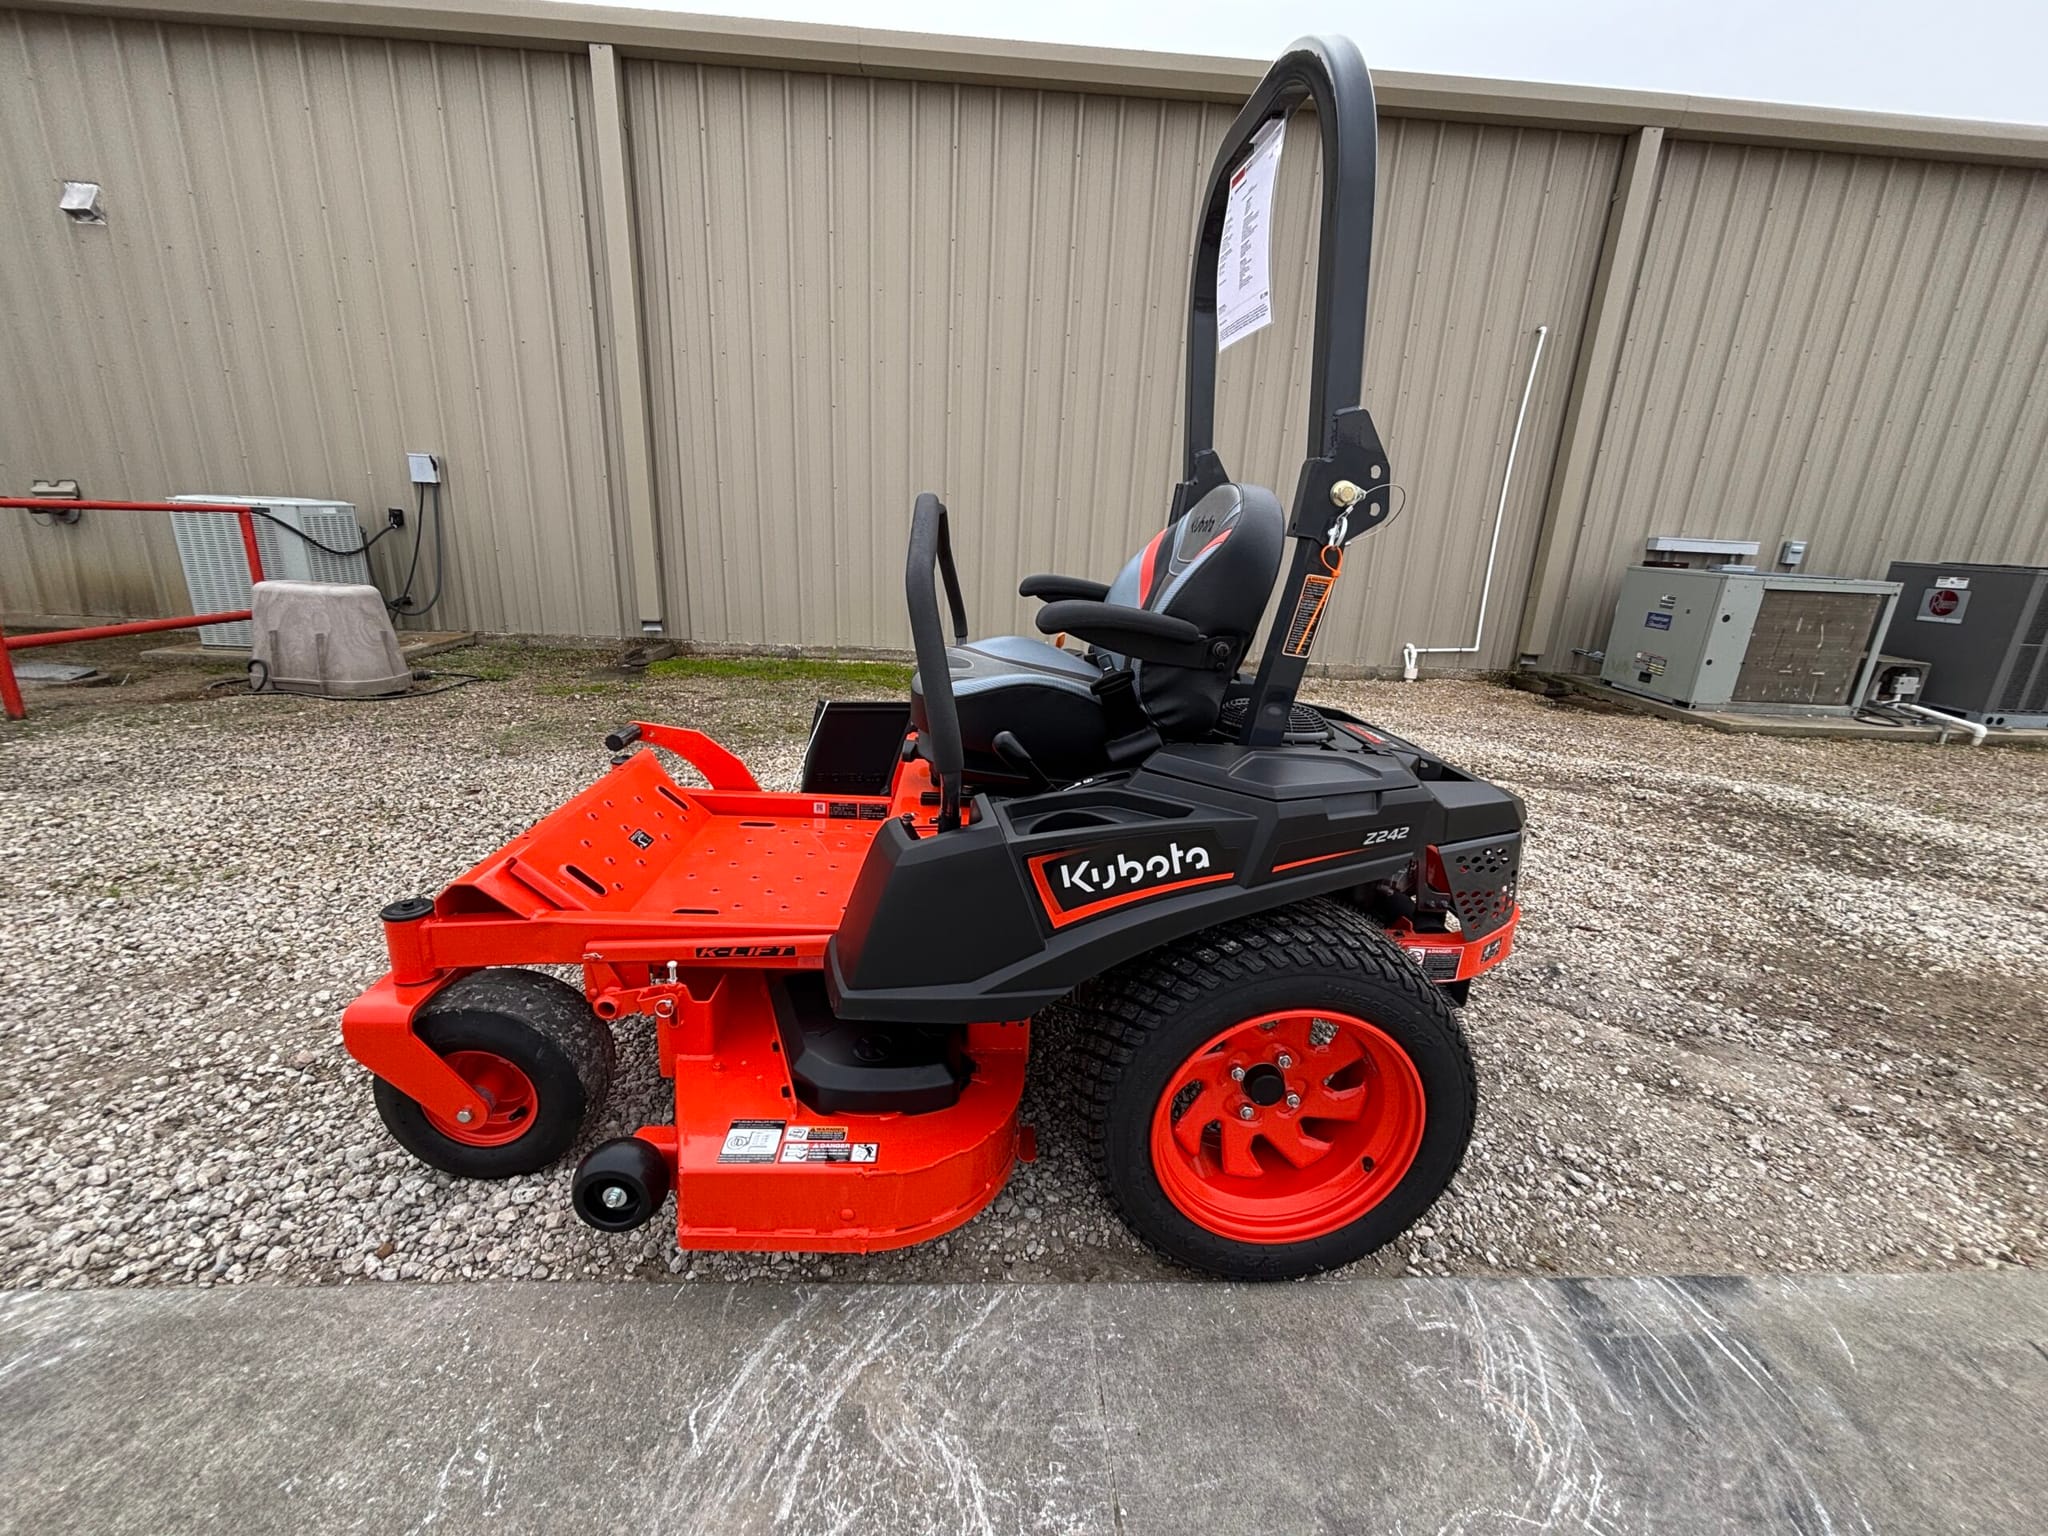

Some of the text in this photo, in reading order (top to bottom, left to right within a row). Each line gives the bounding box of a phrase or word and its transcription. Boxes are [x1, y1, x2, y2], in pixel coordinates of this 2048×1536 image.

[1363, 826, 1410, 846] Z242
[1060, 842, 1210, 893] Kubota
[699, 946, 793, 957] K-LIFT
